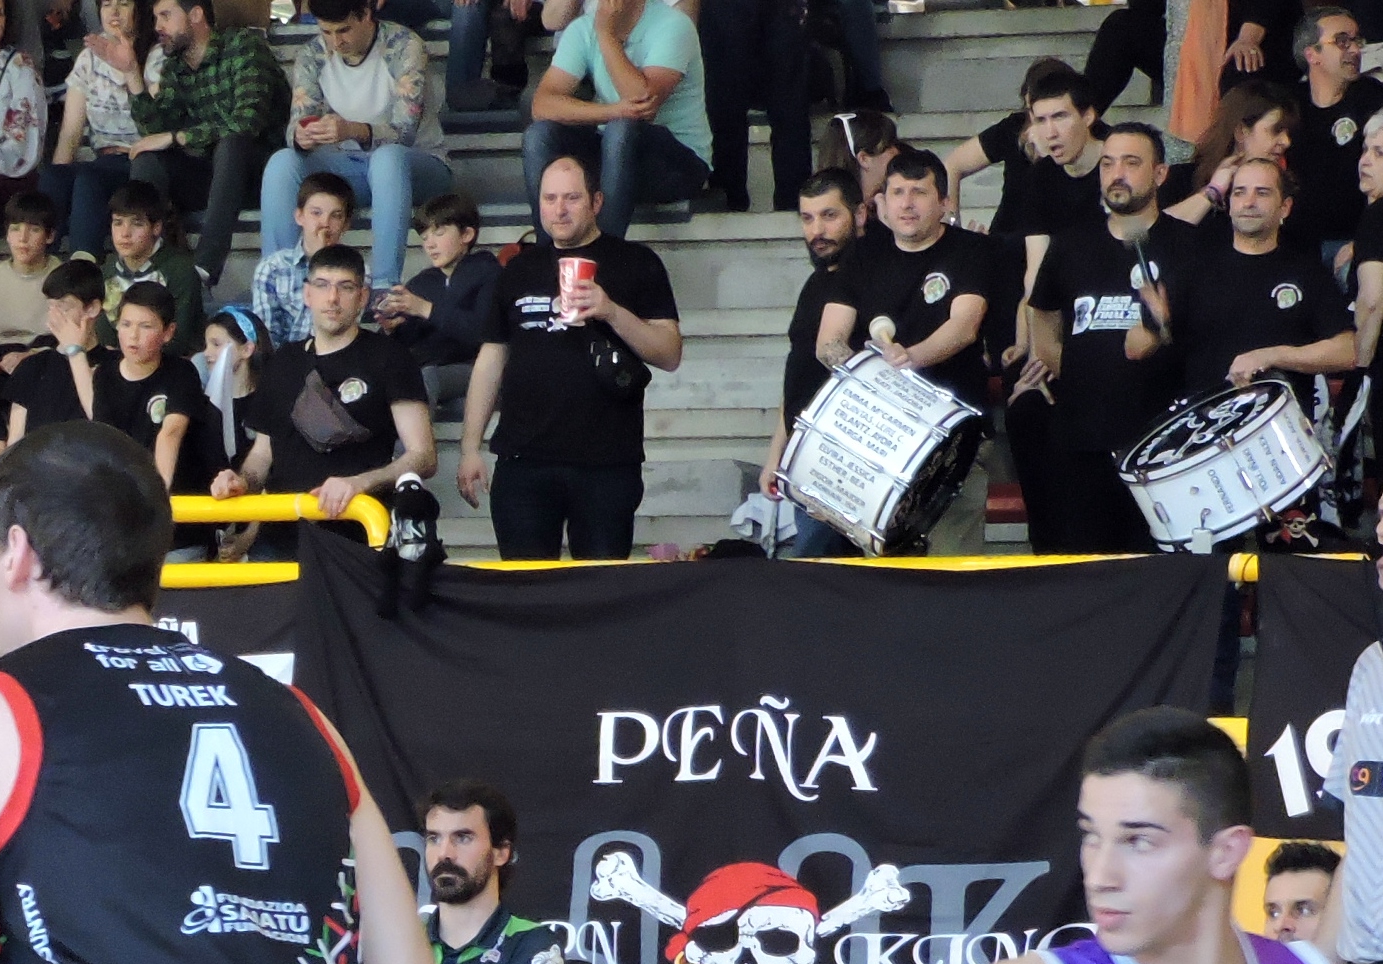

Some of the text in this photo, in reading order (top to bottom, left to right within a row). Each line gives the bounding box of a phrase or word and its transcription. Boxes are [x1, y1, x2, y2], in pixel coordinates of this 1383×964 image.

[96, 654, 182, 673] for all
[128, 683, 238, 707] TUREK
[592, 695, 877, 802] PEÑA
[179, 723, 280, 870] 4
